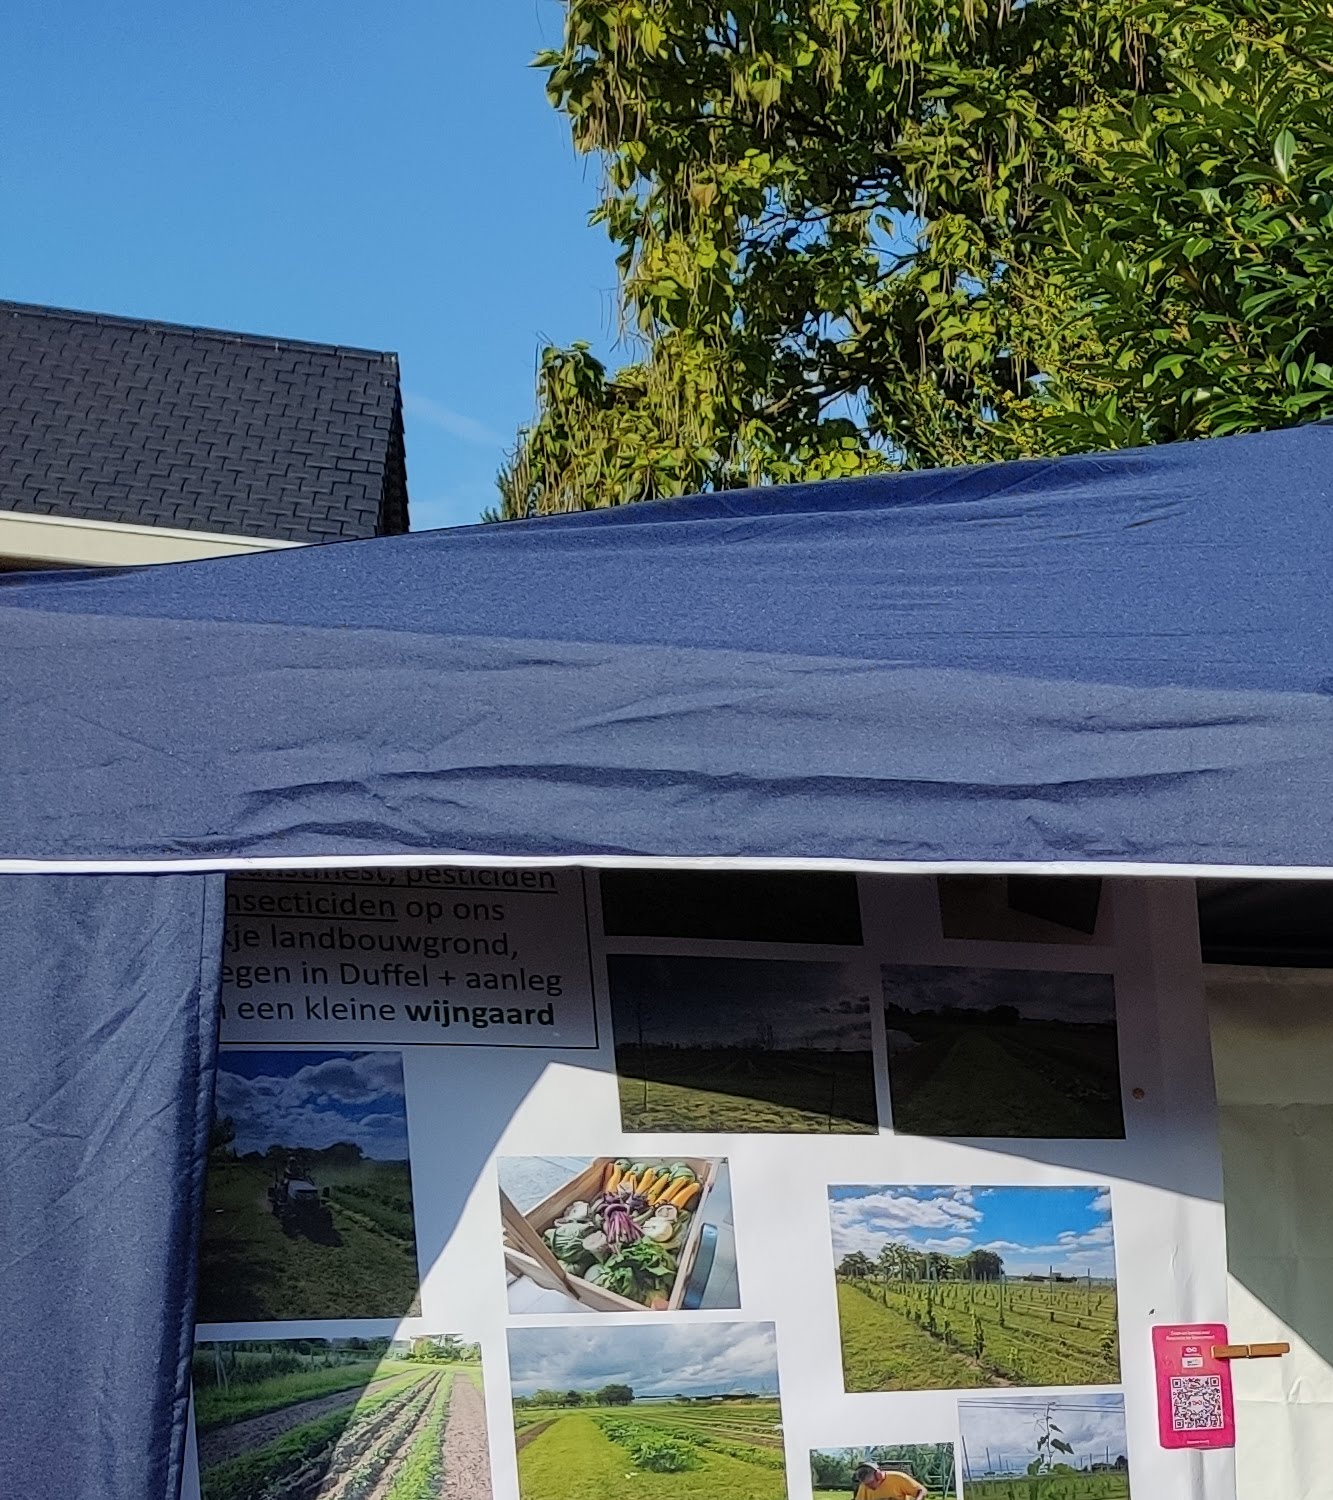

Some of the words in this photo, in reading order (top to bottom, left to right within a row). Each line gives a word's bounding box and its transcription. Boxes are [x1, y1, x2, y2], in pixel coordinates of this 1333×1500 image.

[406, 901, 443, 924] op
[453, 902, 505, 921] ons
[270, 923, 518, 960] landbouwgrond,
[303, 961, 329, 985] in
[339, 962, 429, 988] Duffel
[438, 970, 456, 986] +
[465, 967, 563, 997] aanleg
[237, 1002, 294, 1021] een
[305, 995, 396, 1021] kleine
[404, 999, 555, 1029] wijngaard
